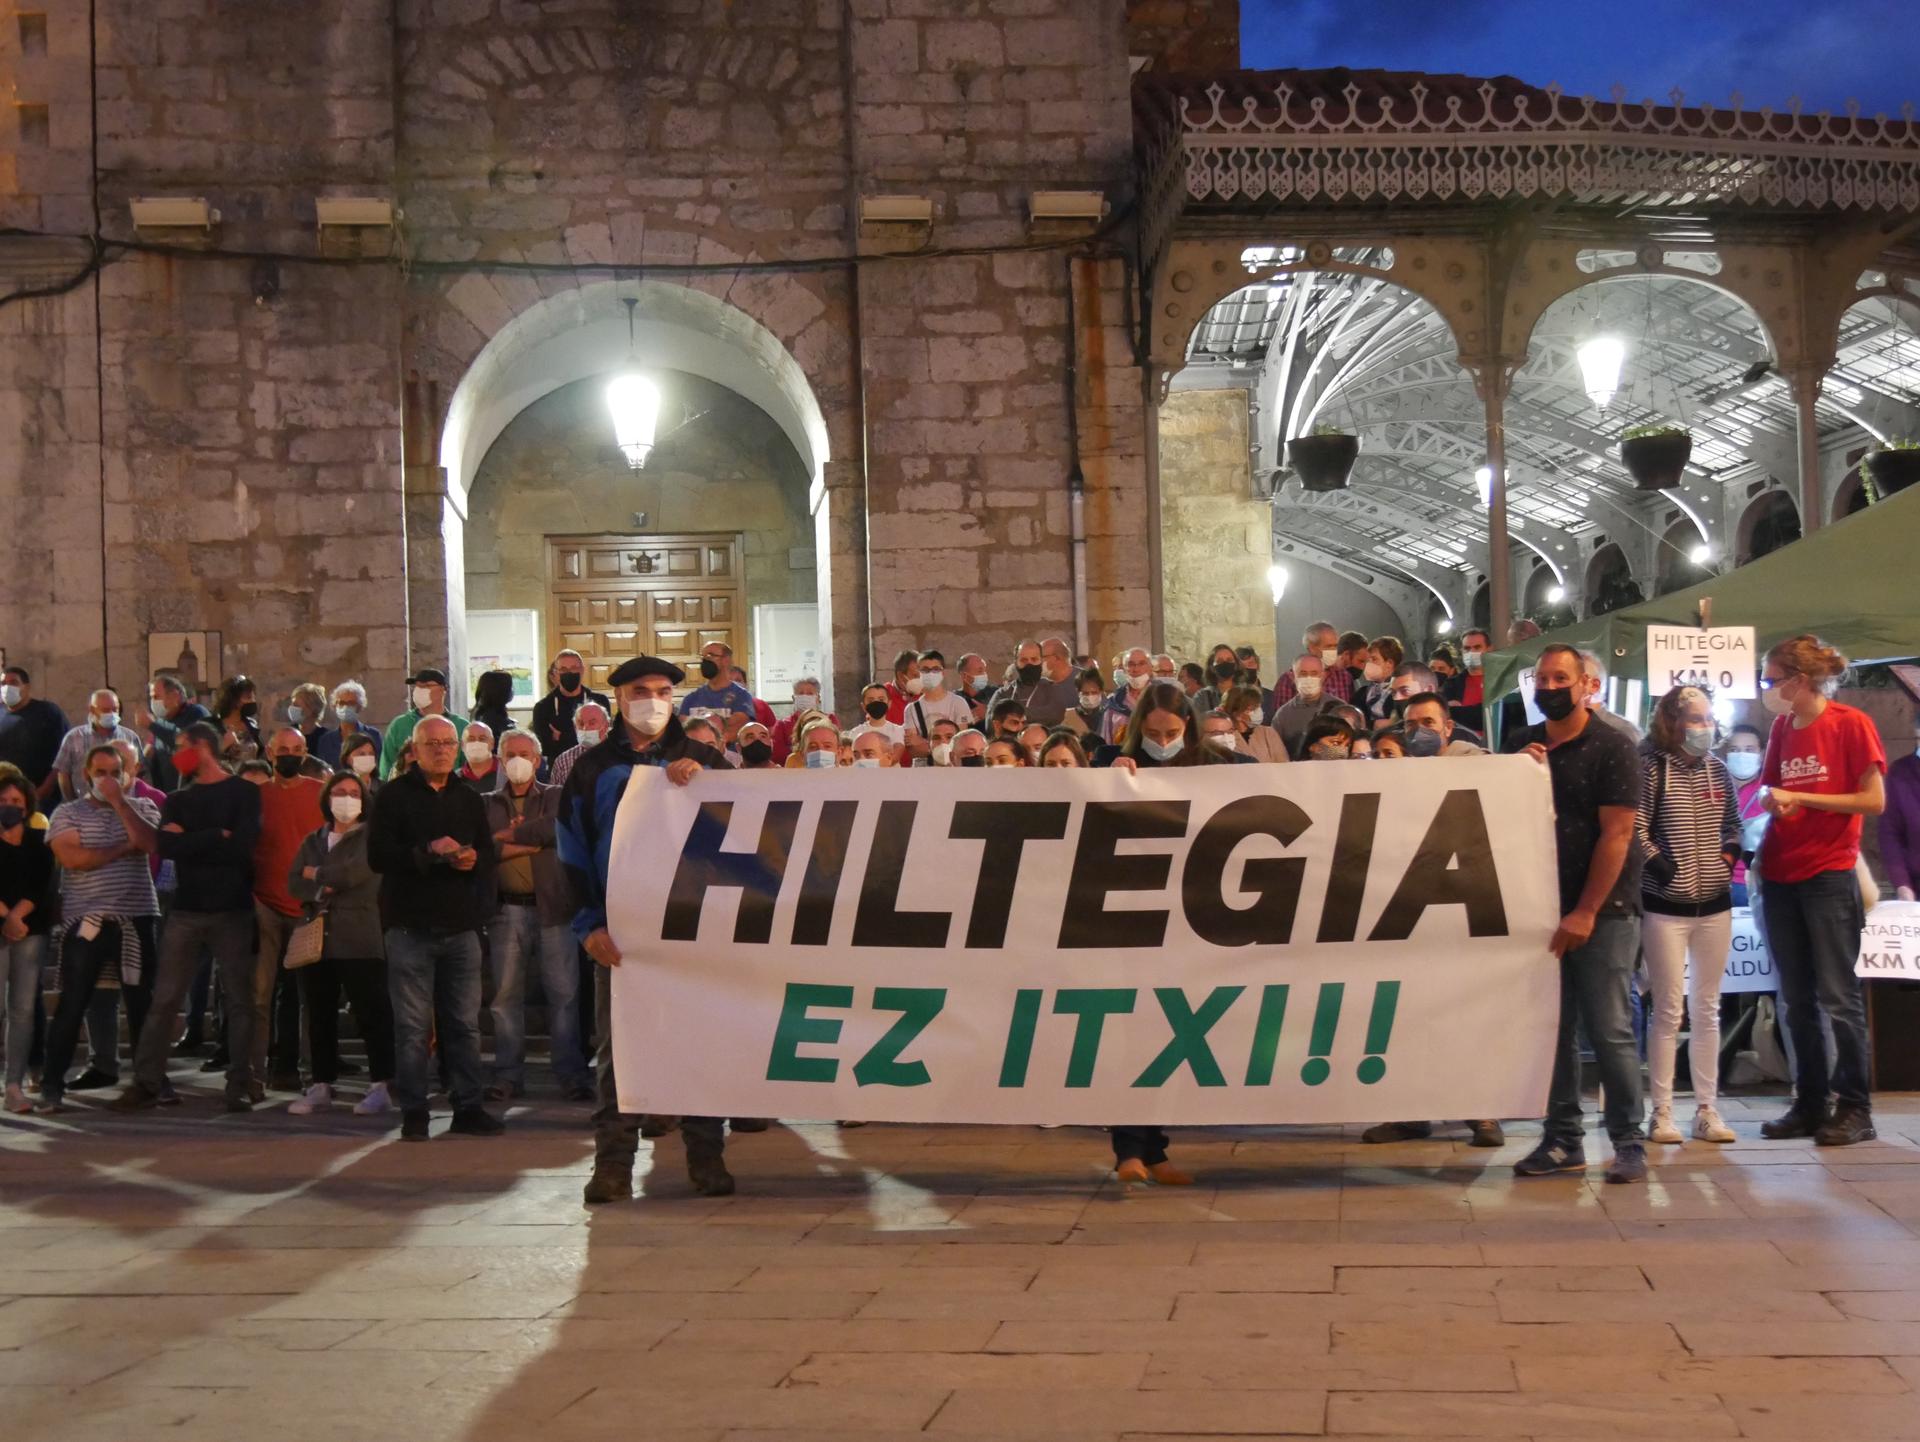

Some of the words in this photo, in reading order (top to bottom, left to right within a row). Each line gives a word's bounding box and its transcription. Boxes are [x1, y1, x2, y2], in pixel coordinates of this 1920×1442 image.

[1653, 633, 1748, 652] HILTEGIA
[661, 789, 1511, 949] HILTEGIA
[1862, 952, 1906, 970] KM
[766, 981, 948, 1087] EZ
[998, 980, 1401, 1087] ITXI!!
